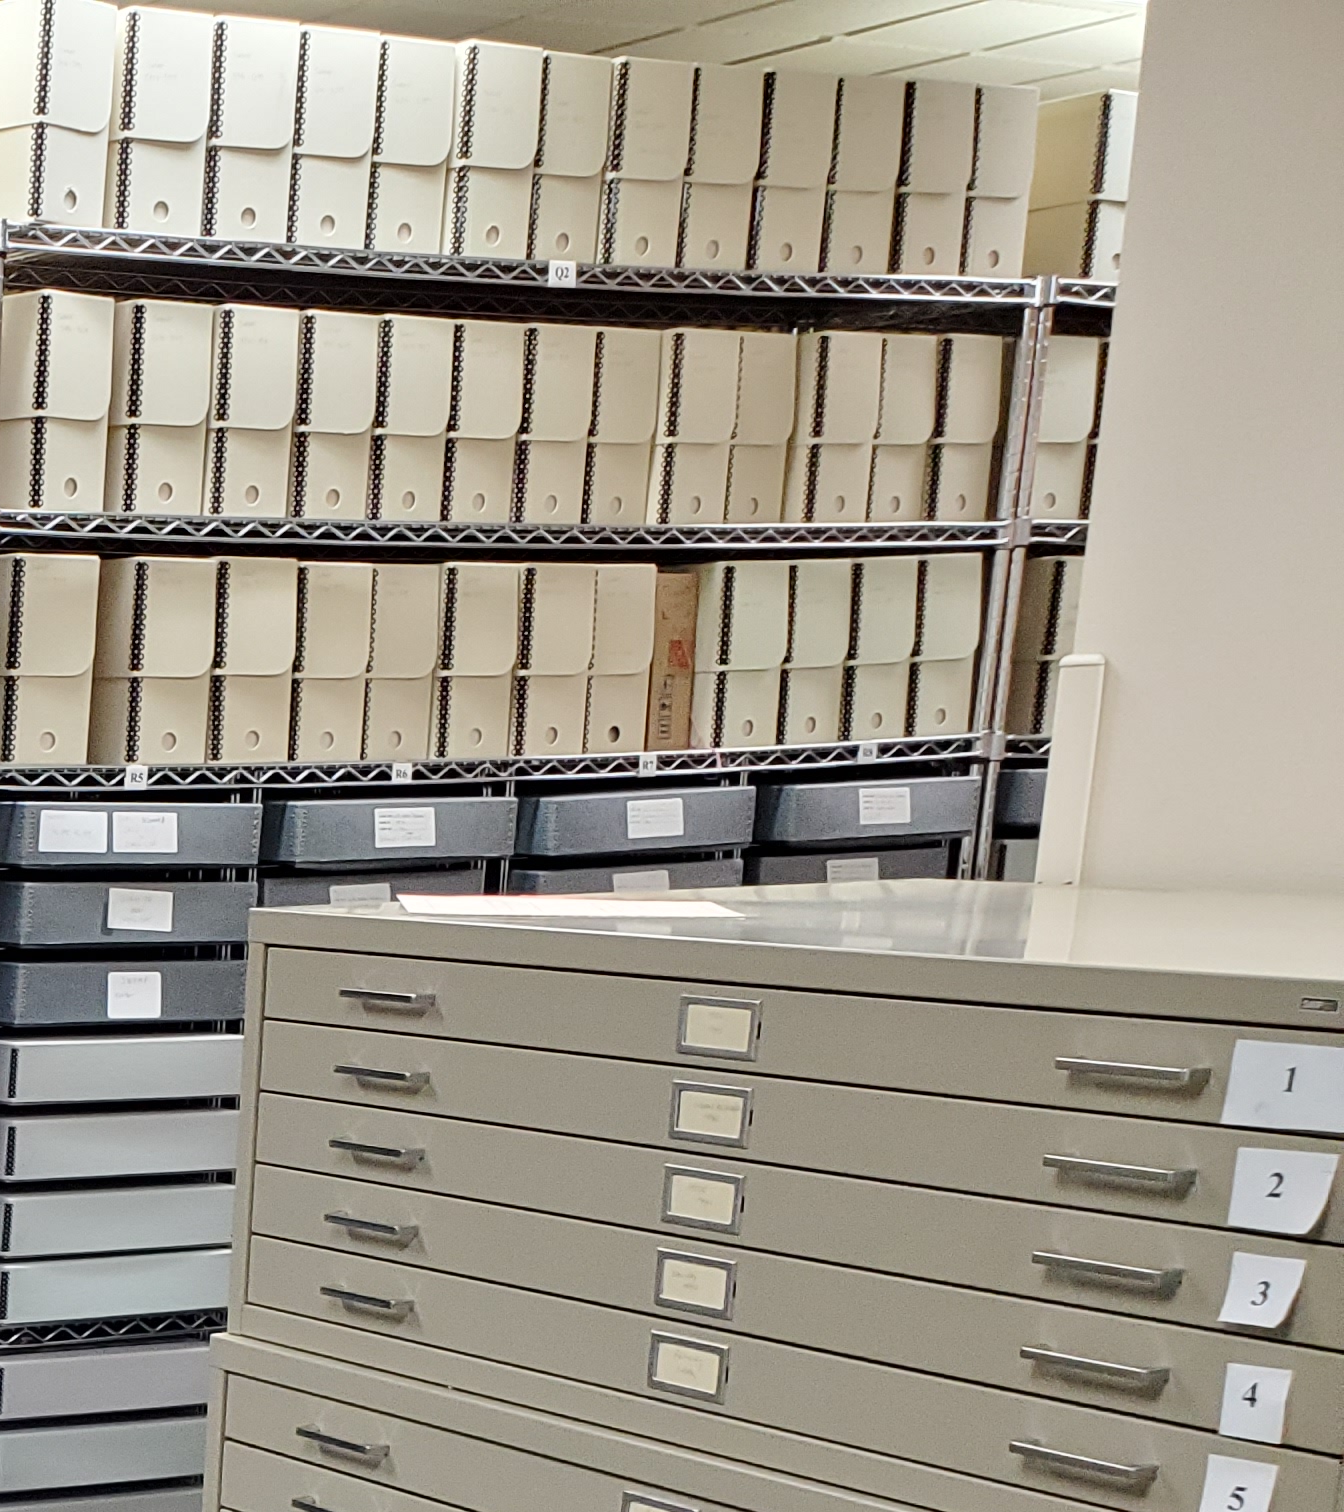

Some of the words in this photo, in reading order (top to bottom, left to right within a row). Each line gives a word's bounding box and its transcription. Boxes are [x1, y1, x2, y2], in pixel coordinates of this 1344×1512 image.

[555, 266, 570, 279] Q2
[396, 769, 408, 779] R6
[643, 760, 654, 771] R7
[130, 772, 144, 784] R5
[1284, 1067, 1296, 1092] 1
[1266, 1173, 1283, 1197] 2
[1251, 1281, 1270, 1305] 3
[1243, 1383, 1257, 1407] 4
[1228, 1487, 1247, 1510] 5
